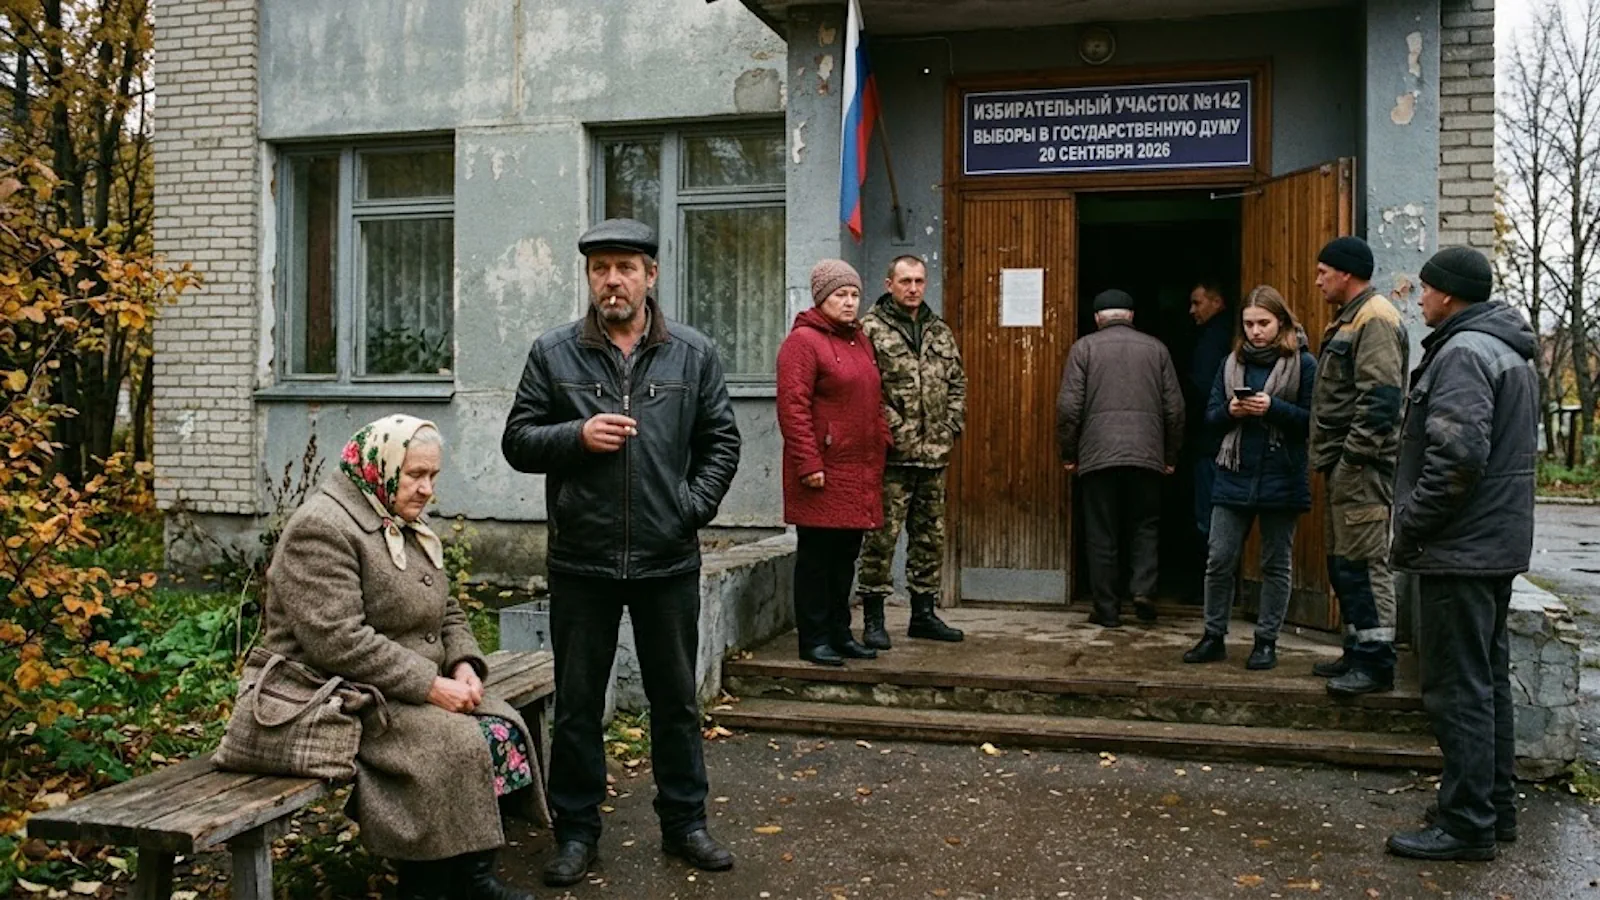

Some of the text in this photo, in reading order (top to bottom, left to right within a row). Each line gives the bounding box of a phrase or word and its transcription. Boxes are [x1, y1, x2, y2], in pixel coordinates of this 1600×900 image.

[973, 91, 1241, 120] ИЗБИРАТЕЛЬНЫЙ УЧАСТОК №142
[973, 118, 1241, 144] ВЫБОРЫ В ГОСУДАРСТВЕННУЮ ДУМУ
[1039, 142, 1171, 162] 20 СЕНТЯБРЯ 2026
